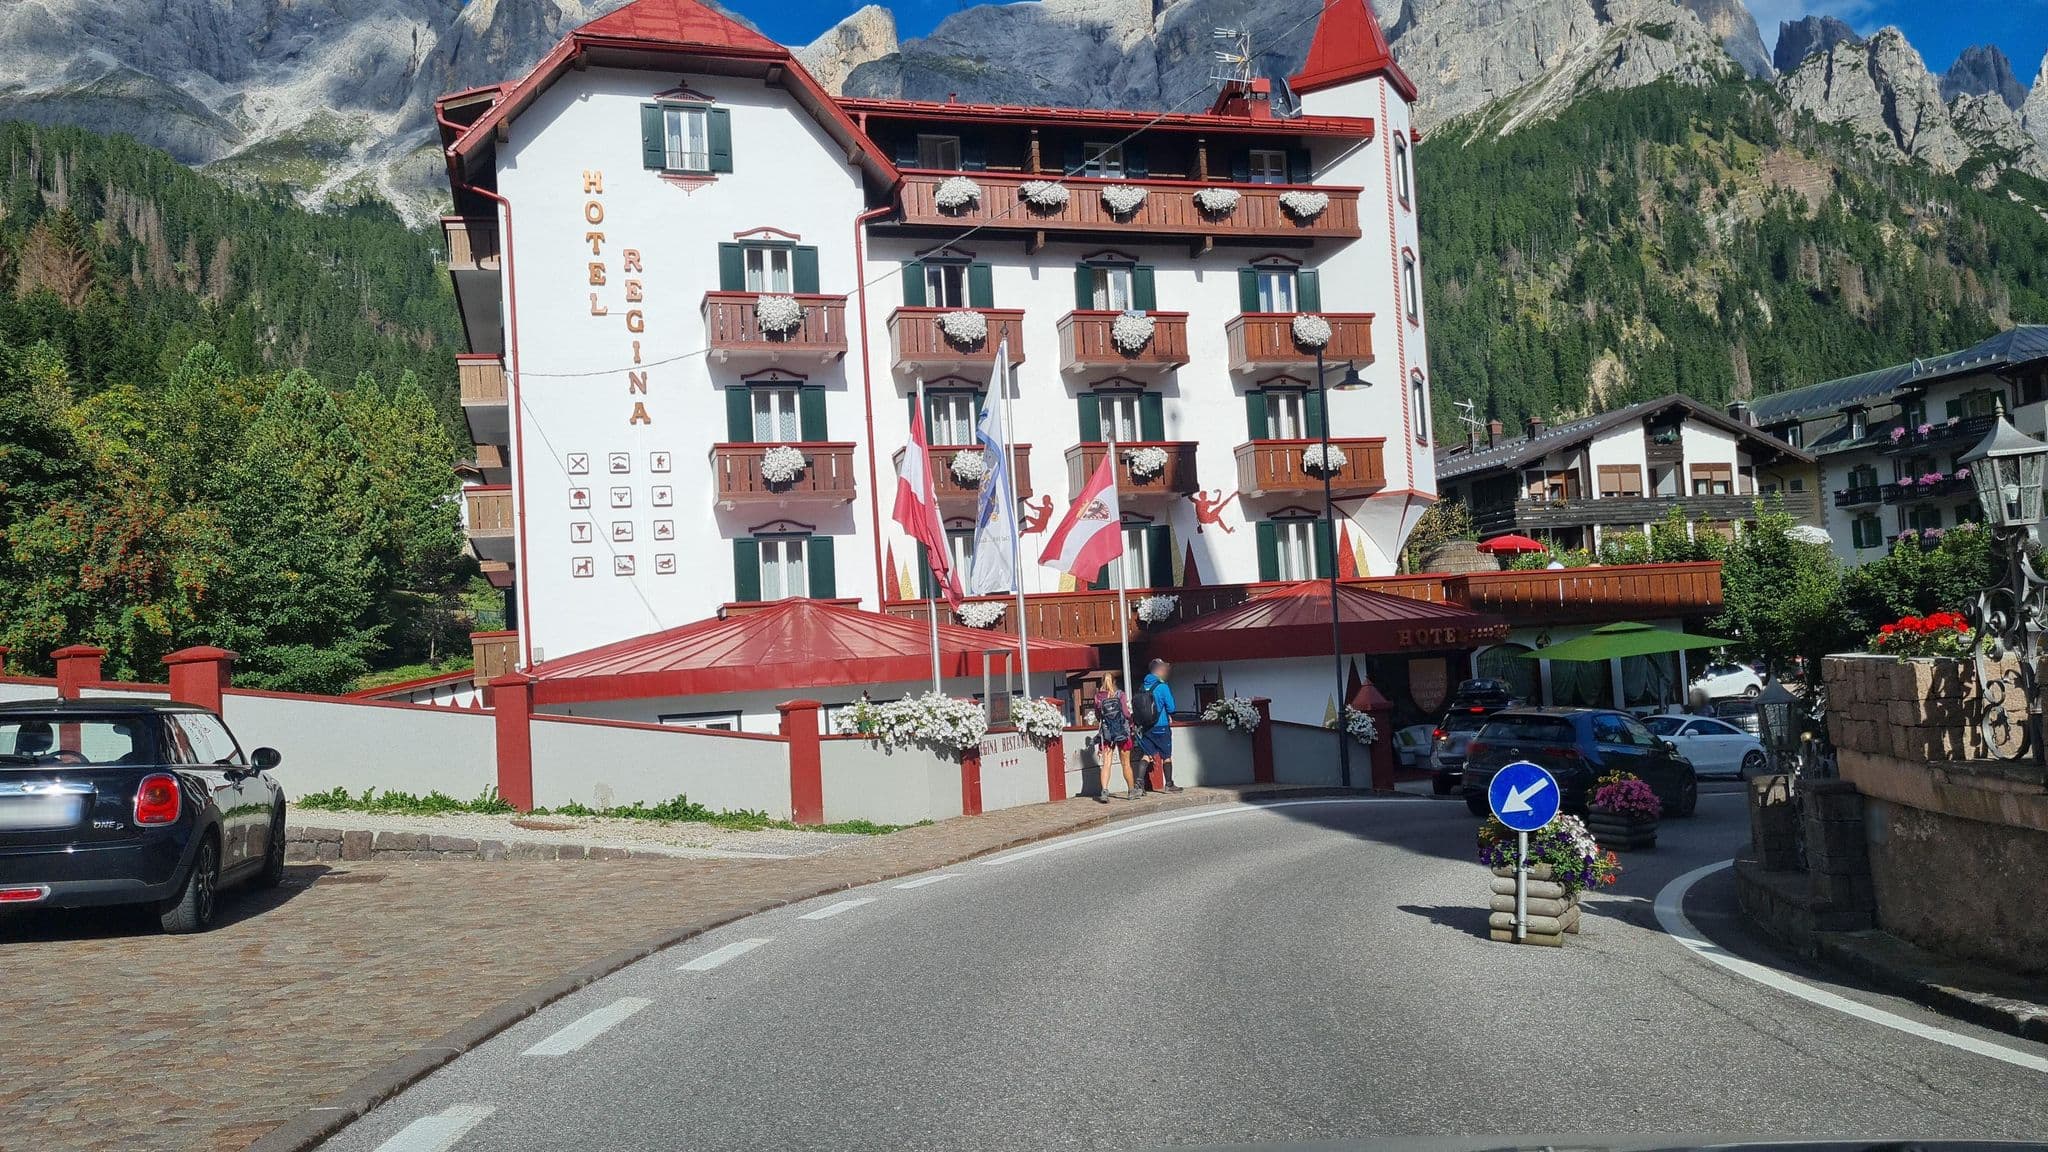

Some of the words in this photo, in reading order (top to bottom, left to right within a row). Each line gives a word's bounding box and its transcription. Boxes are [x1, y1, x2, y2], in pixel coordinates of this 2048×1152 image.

[582, 170, 608, 316] HOTEL
[623, 248, 651, 425] REGINA
[94, 821, 115, 829] ONE
